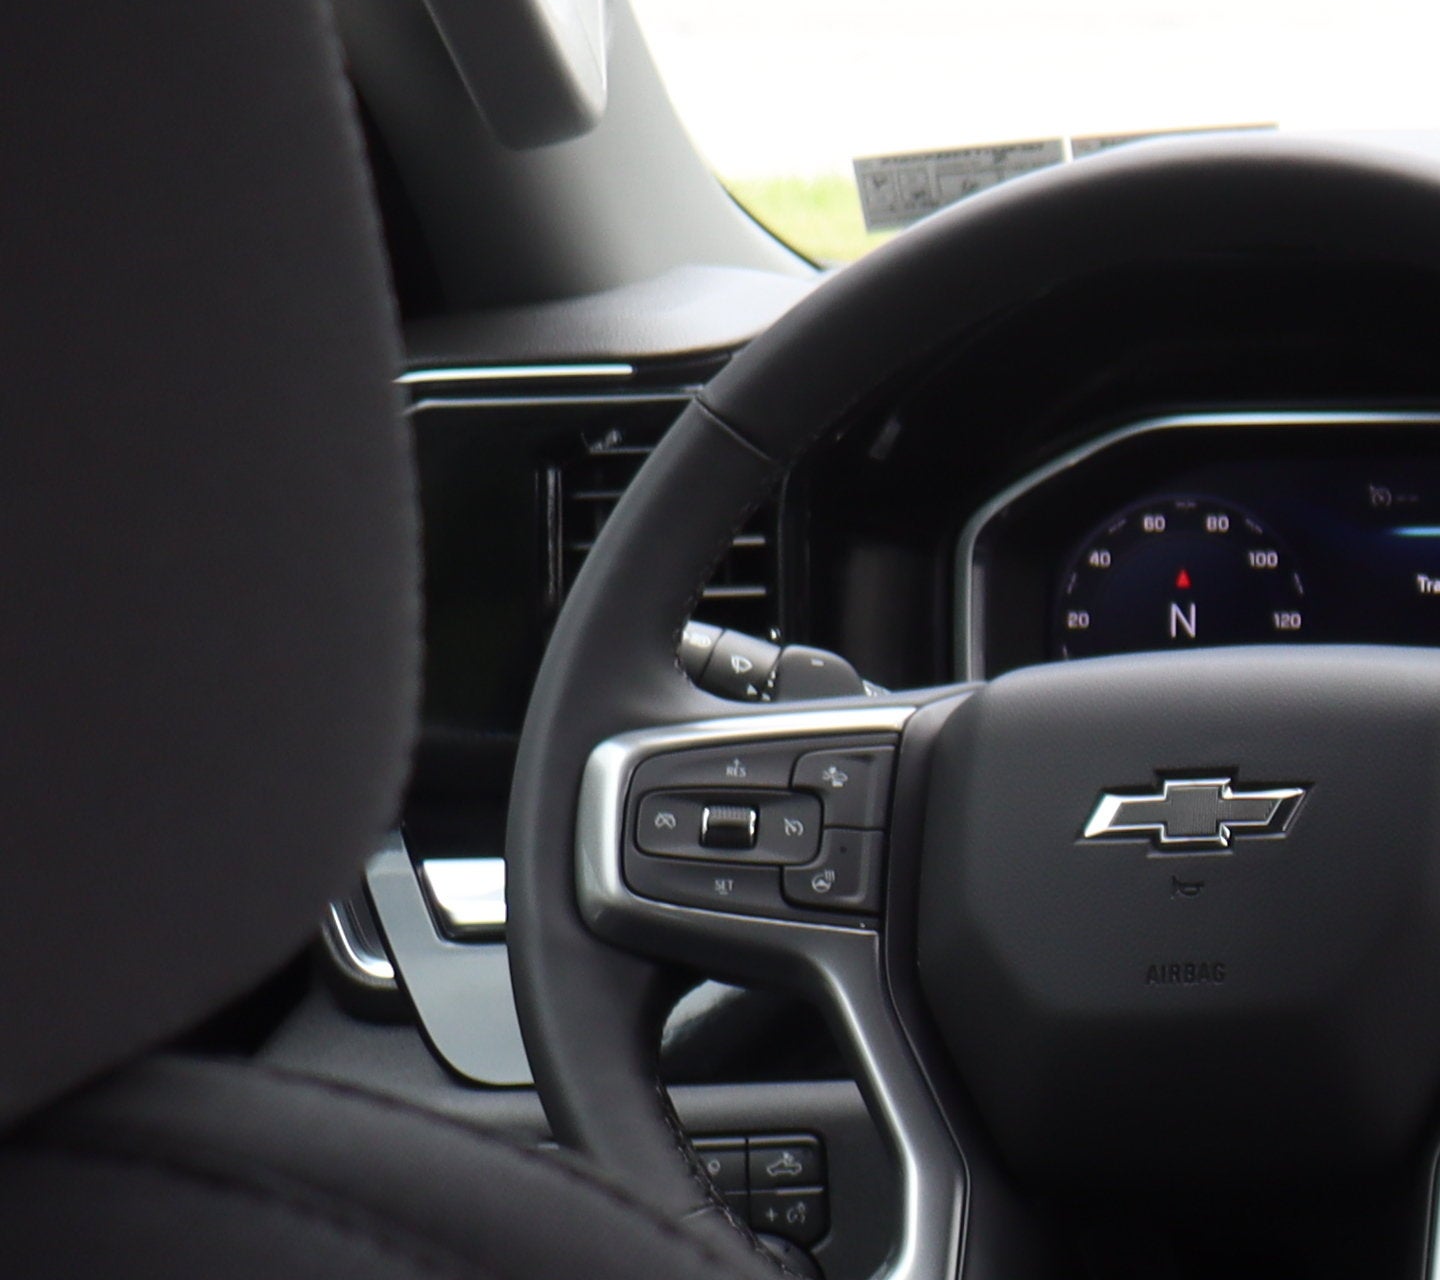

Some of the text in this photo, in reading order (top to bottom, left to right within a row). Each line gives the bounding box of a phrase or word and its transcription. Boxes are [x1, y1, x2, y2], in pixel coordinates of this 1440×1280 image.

[1143, 516, 1166, 532] 60
[1206, 516, 1230, 532] 80
[1088, 550, 1112, 568] 40
[1248, 550, 1278, 568] 100
[1067, 612, 1090, 629] 20
[1169, 602, 1196, 639] N
[1274, 612, 1302, 629] 120
[1147, 962, 1226, 983] AIRBAG
